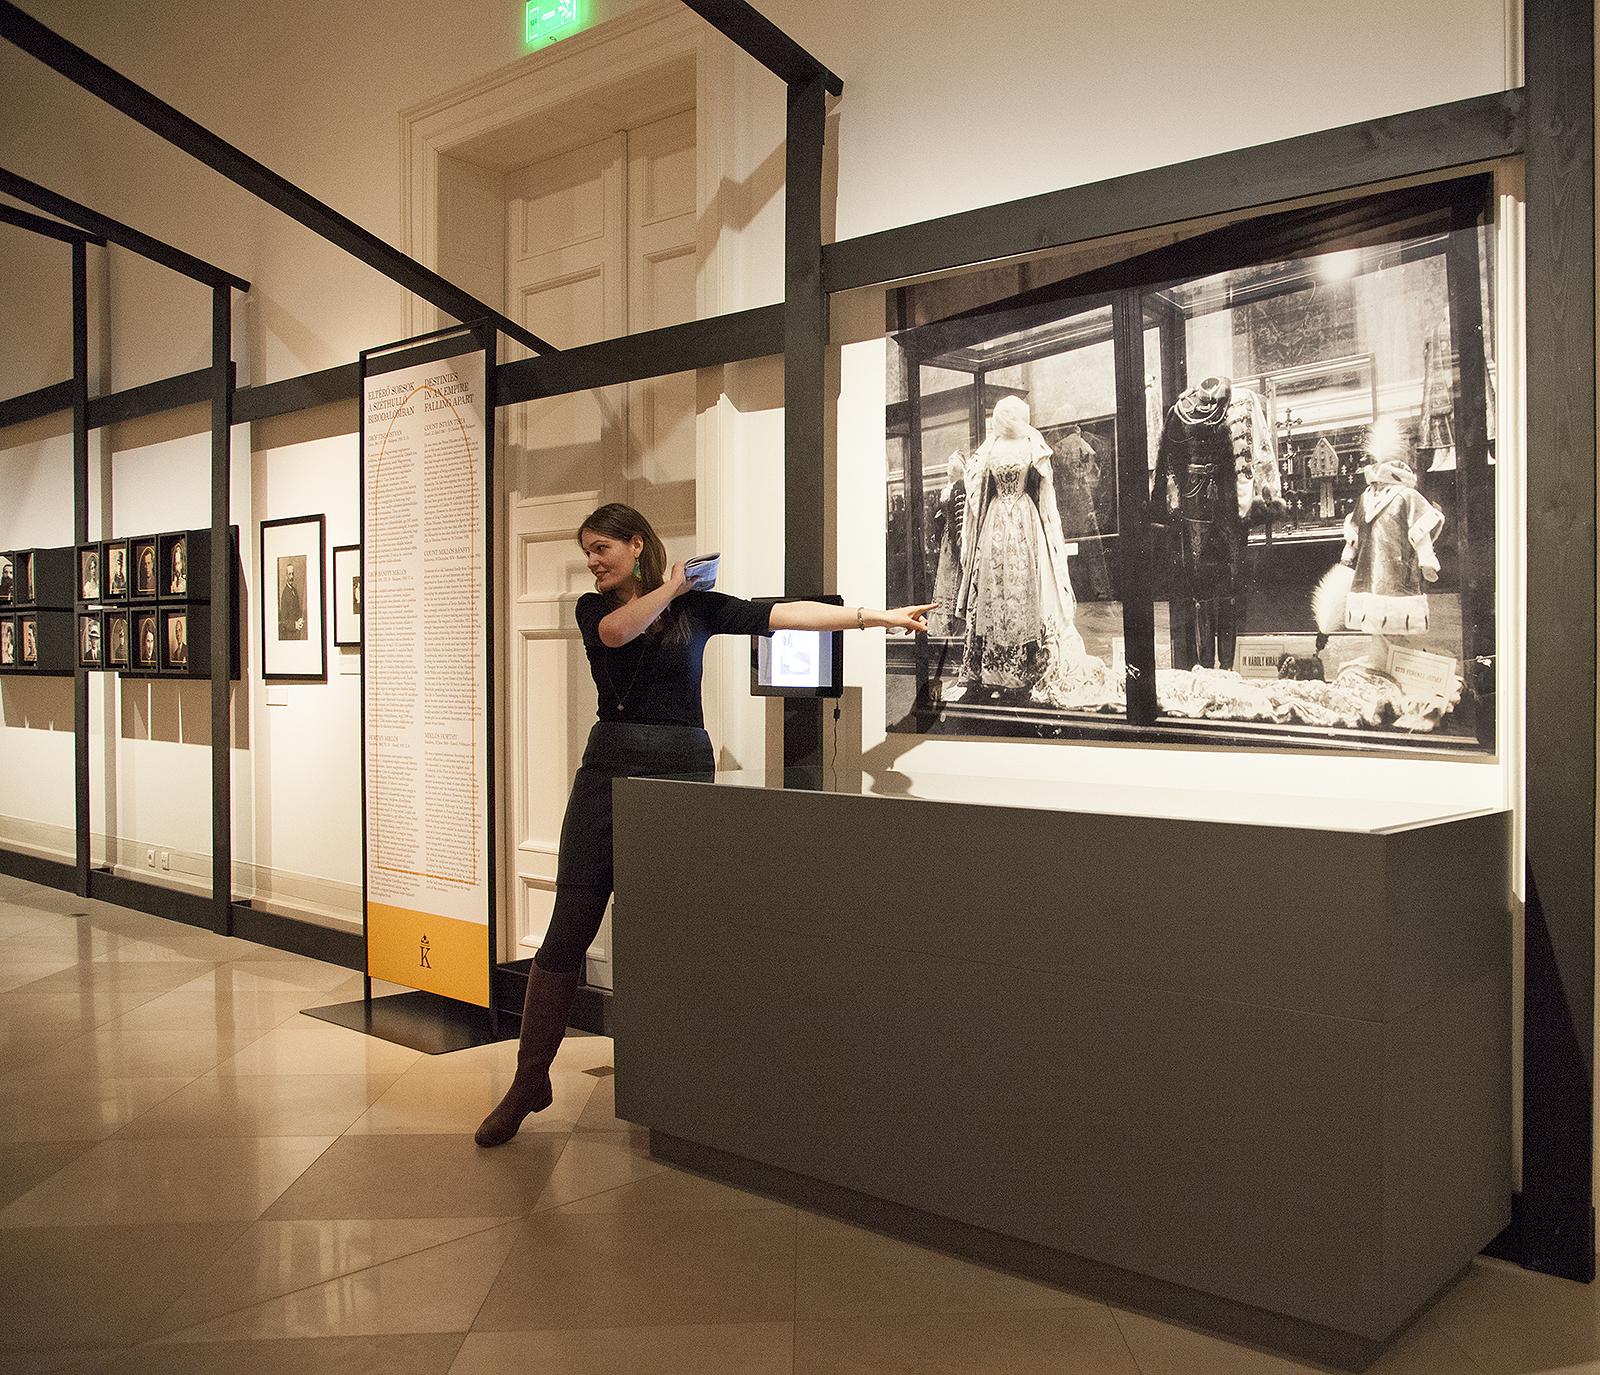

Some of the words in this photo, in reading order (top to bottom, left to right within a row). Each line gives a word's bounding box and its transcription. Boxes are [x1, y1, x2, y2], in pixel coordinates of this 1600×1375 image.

[424, 371, 458, 387] DESTINIES
[424, 390, 431, 400] IN
[443, 382, 469, 395] EMPIRE
[367, 403, 372, 412] A
[424, 397, 451, 412] FALLING
[452, 393, 474, 406] APART
[418, 943, 432, 969] K
